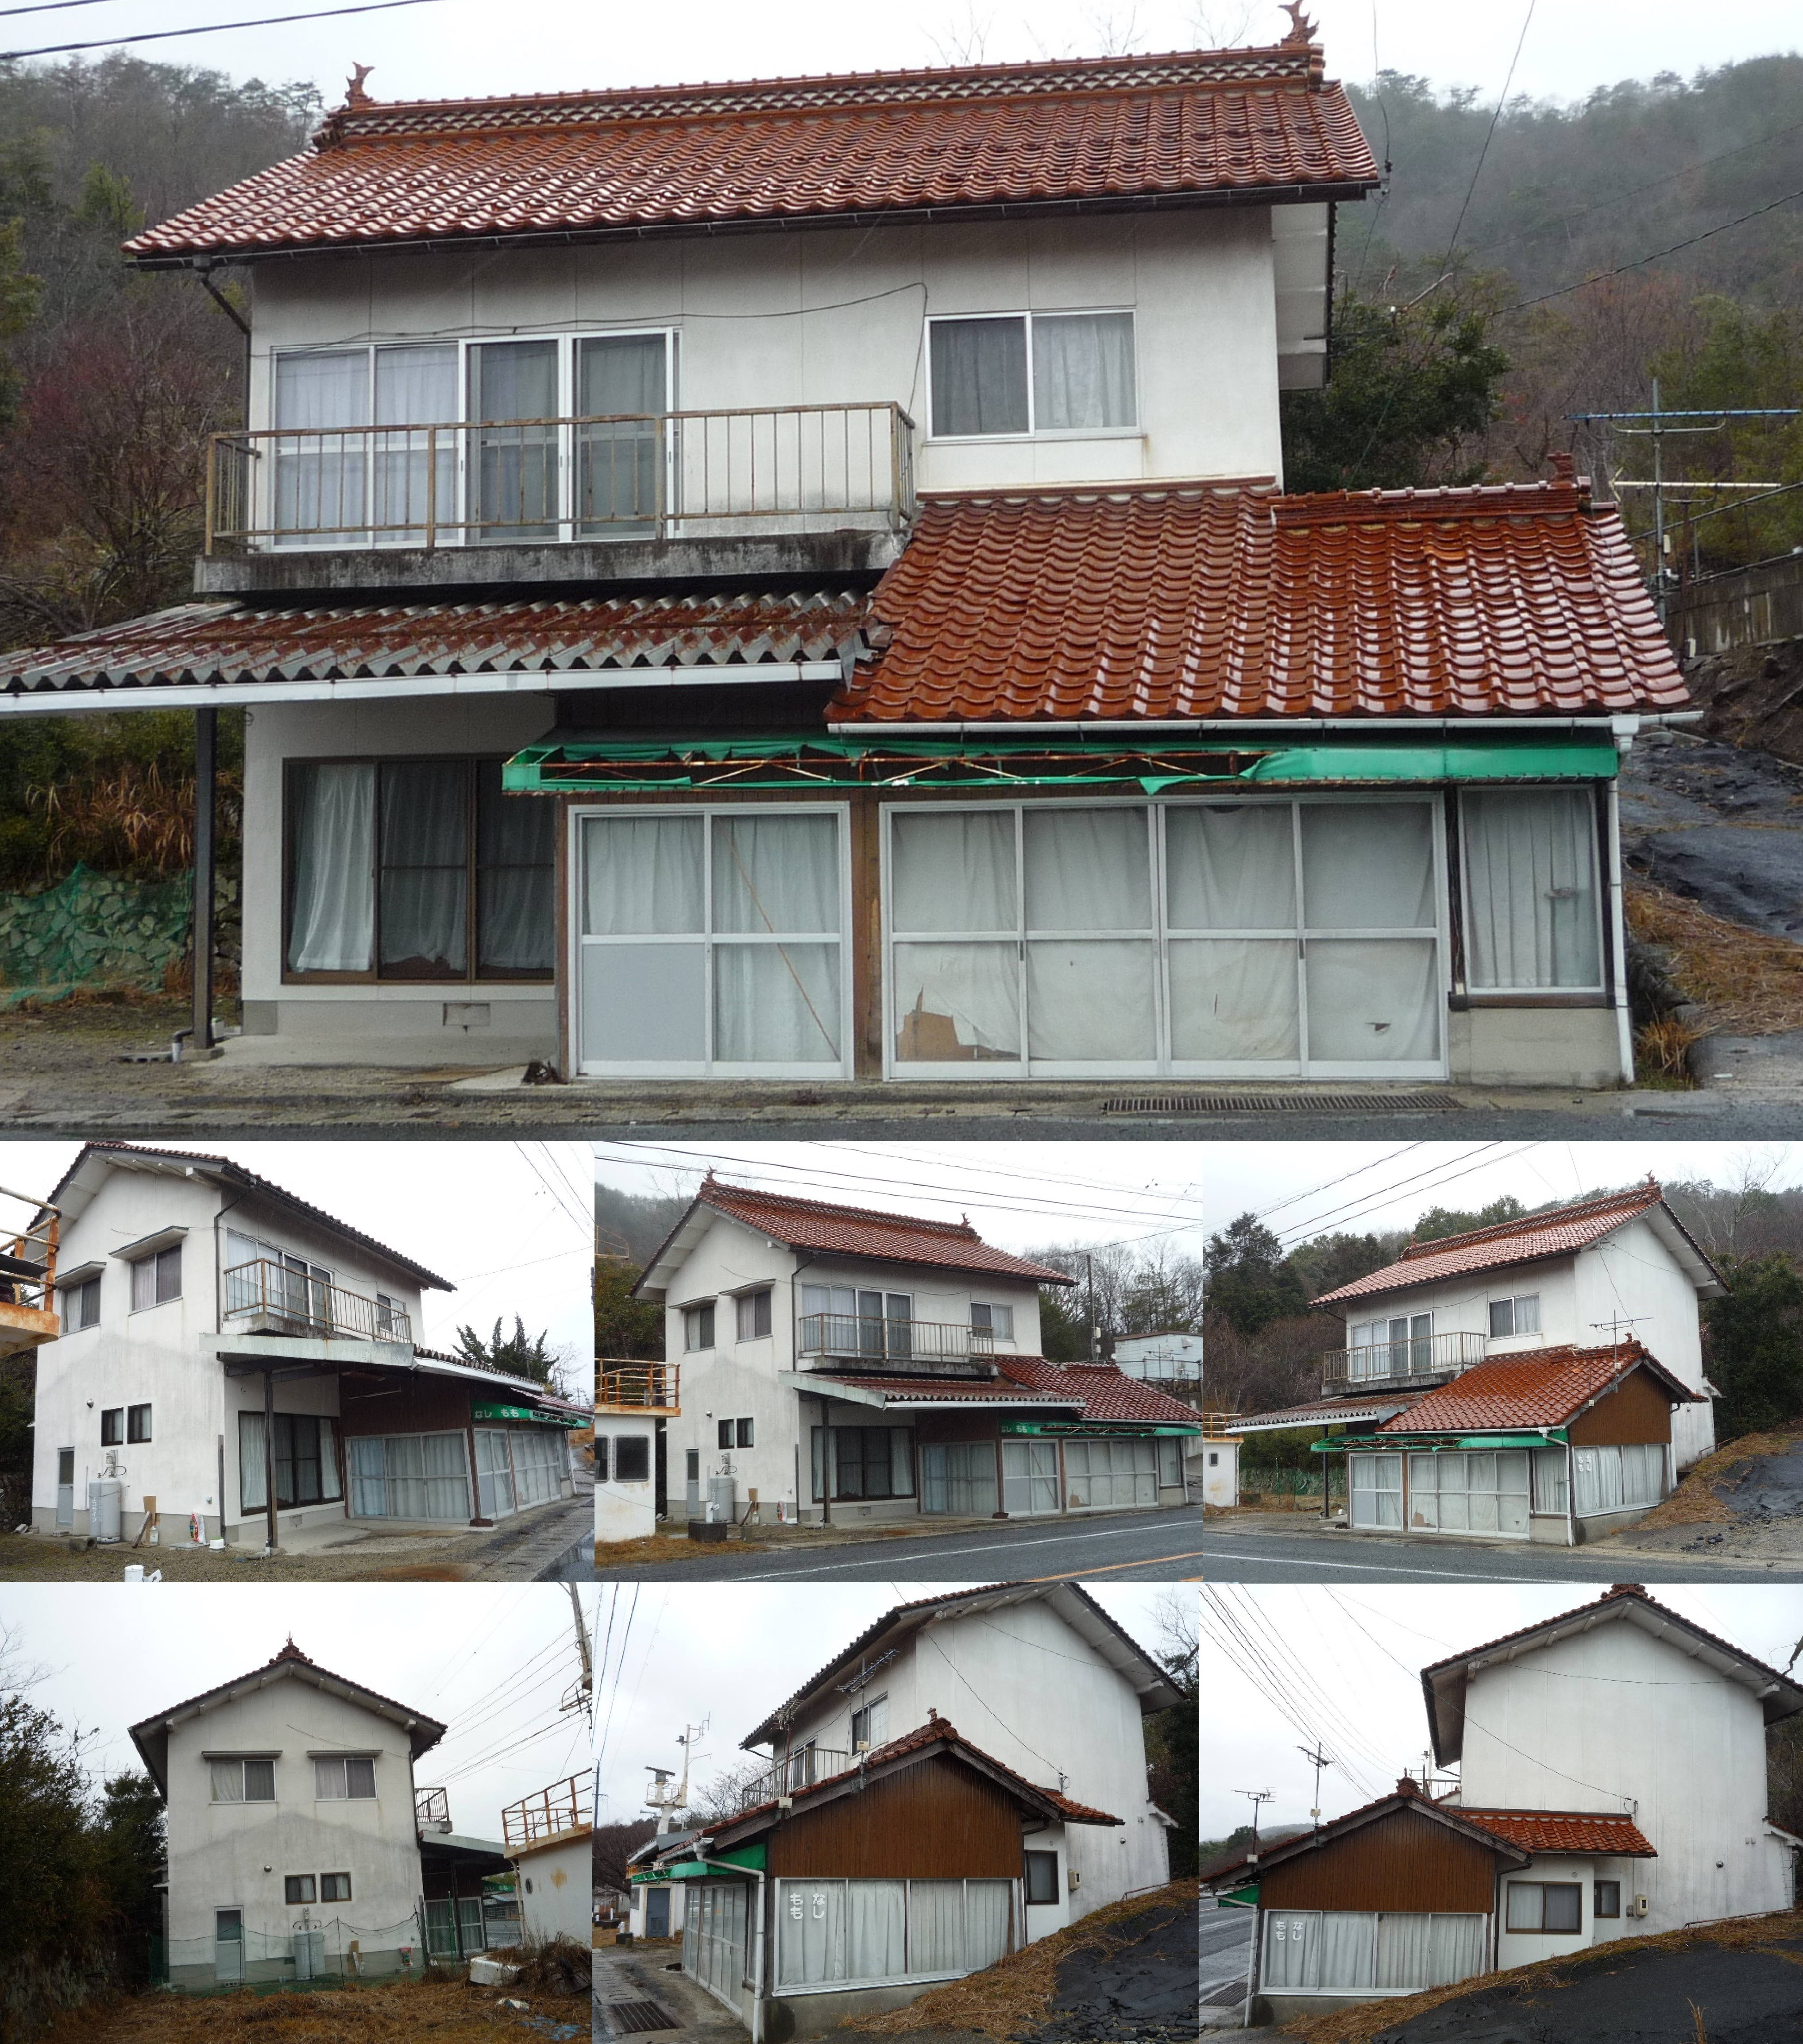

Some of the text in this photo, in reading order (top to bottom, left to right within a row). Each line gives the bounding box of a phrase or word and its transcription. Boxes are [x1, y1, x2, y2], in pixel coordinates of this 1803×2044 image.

[475, 1408, 519, 1419] なし もも
[1578, 1456, 1583, 1472] もも
[1586, 1455, 1592, 1472] なし
[790, 1893, 803, 1920] もも
[812, 1893, 825, 1919] なし
[1275, 1920, 1286, 1941] もも
[1293, 1921, 1303, 1941] なし
